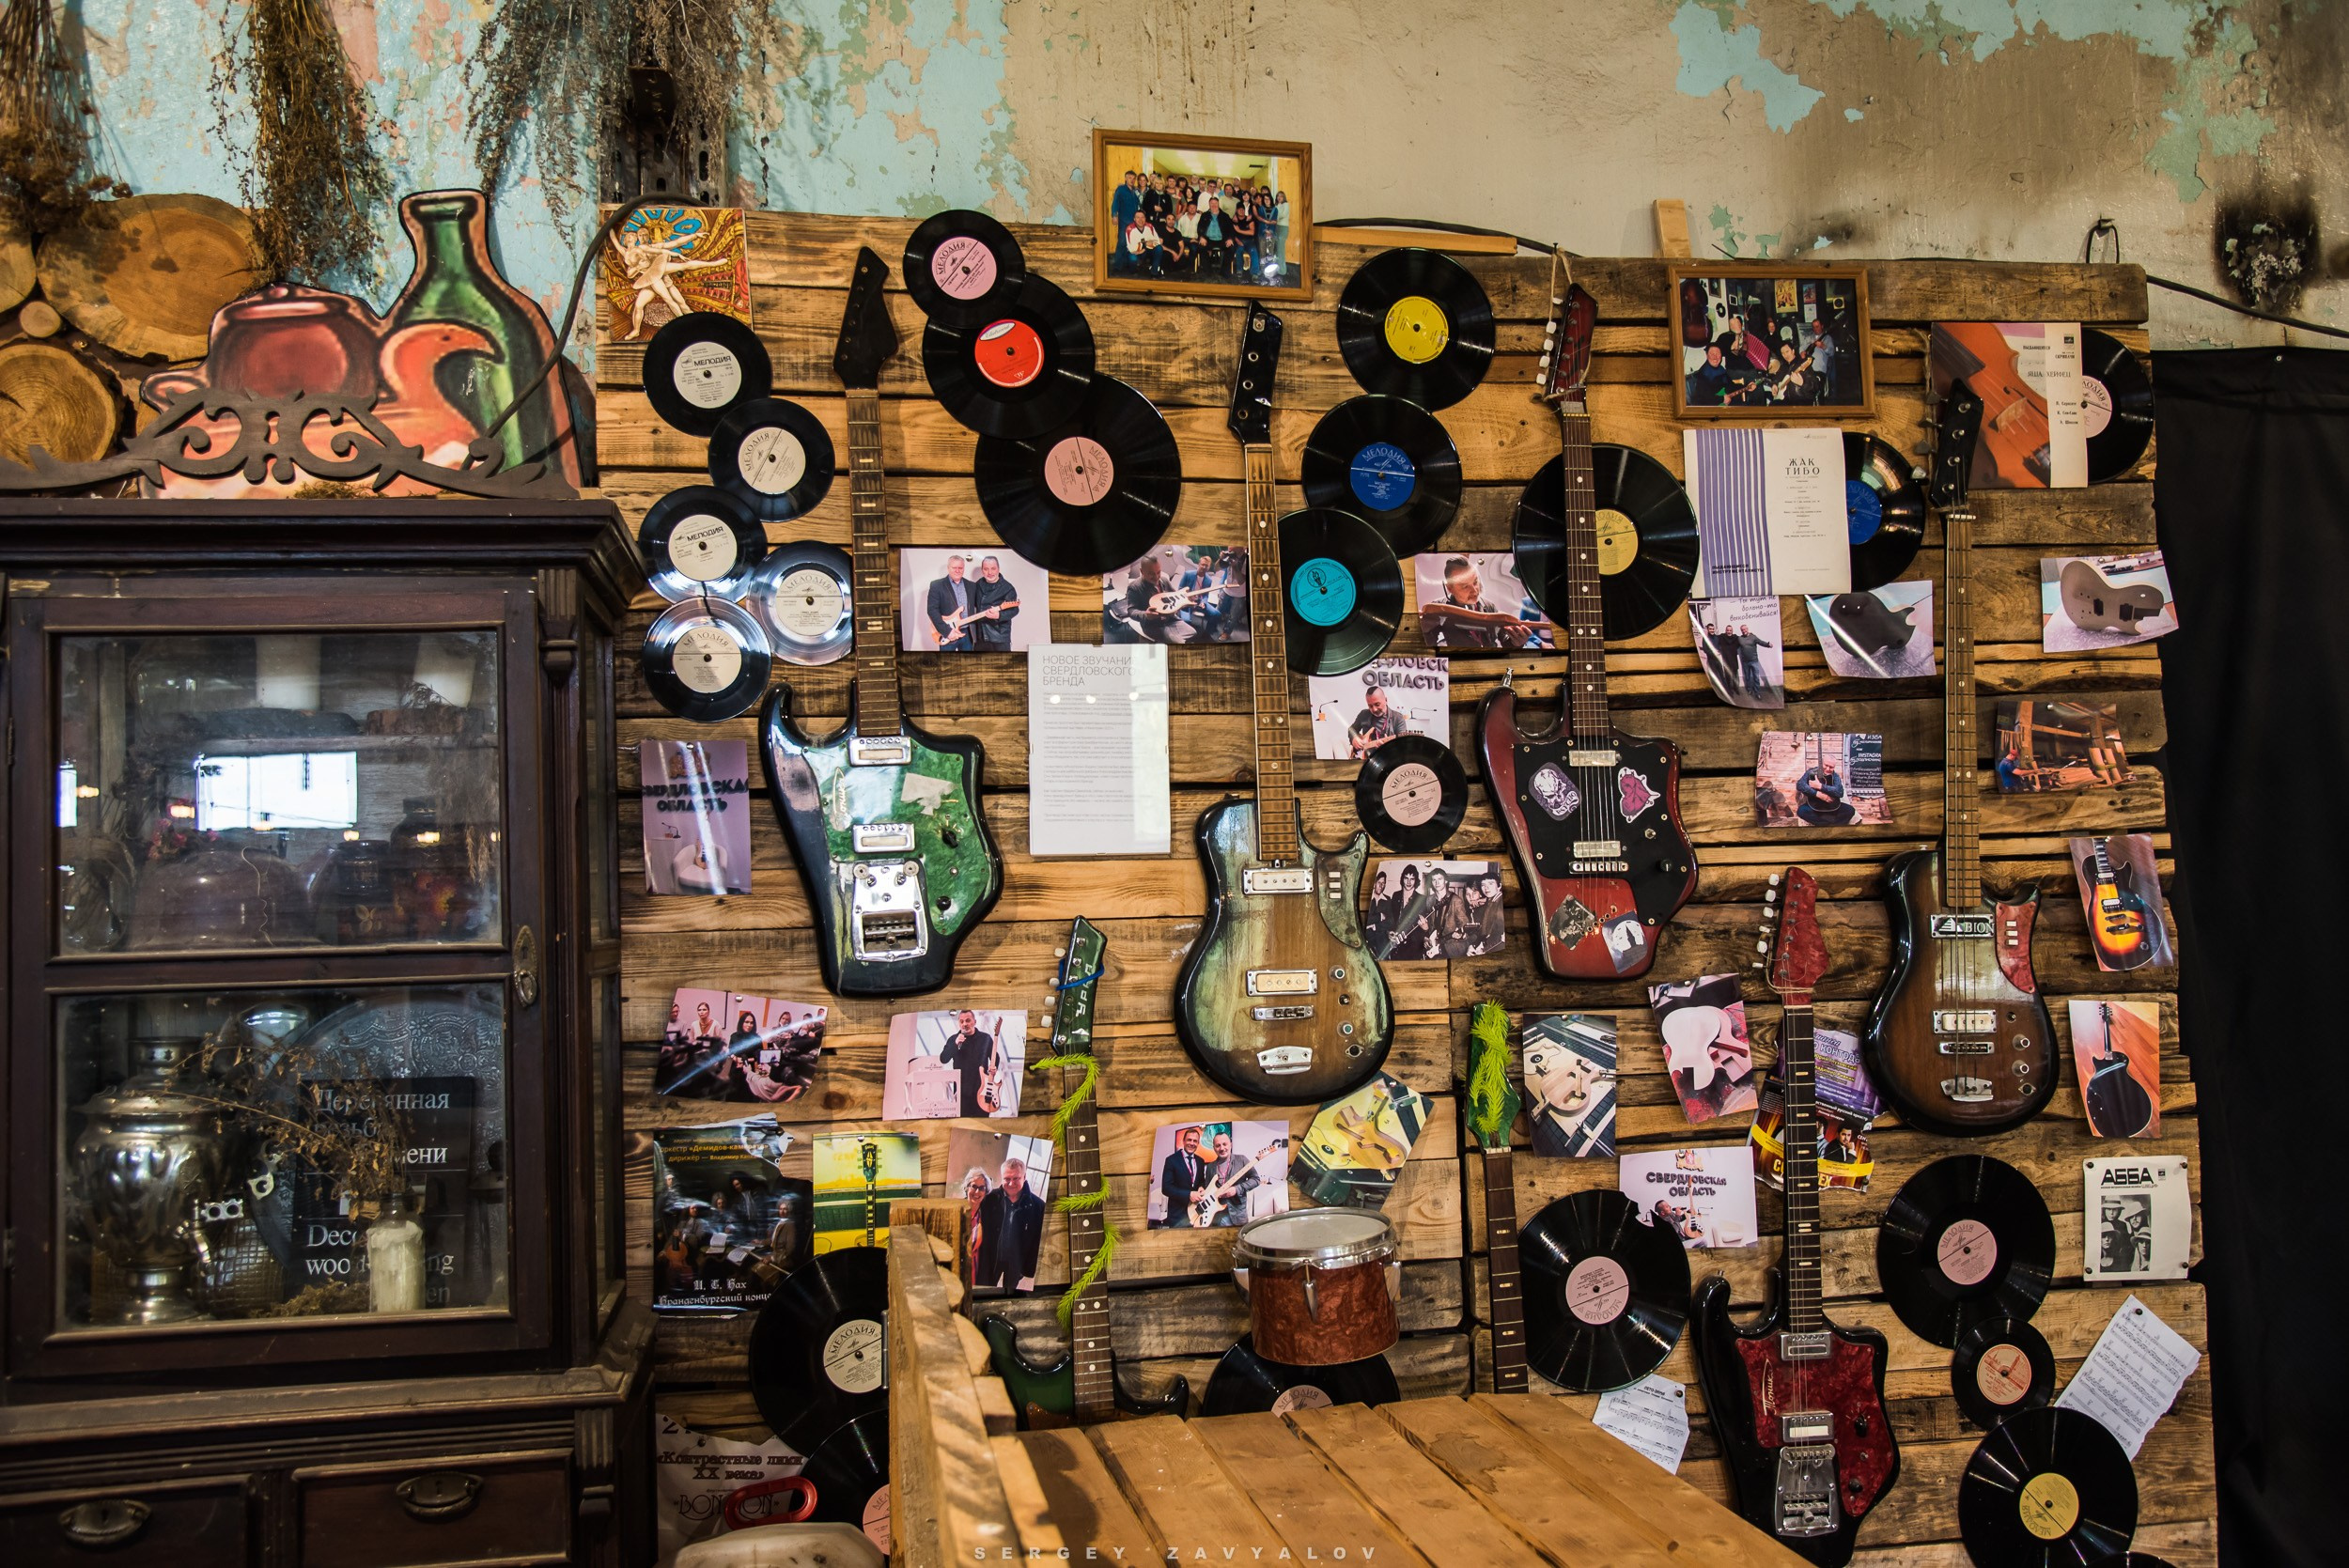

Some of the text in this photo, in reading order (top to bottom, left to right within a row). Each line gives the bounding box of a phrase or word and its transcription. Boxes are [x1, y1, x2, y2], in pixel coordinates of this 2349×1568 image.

[938, 241, 967, 275] МЕЛОДИЯ
[693, 354, 732, 367] МЕЛОДИЯ
[742, 431, 771, 473] МЕЛОДИЯ
[1361, 446, 1408, 467] МЕЛОДИЯ
[1788, 458, 1815, 466] ЖАК
[1088, 445, 1110, 489] МЕЛОДИЯ
[1784, 466, 1821, 475] ТИБО
[686, 525, 724, 542] МЕЛОДИЯ
[786, 573, 832, 591] МЕЛОДИЯ
[683, 631, 730, 647] МЕЛОДИЯ
[1042, 655, 1132, 665] НОВОЕ ЗВУЧАНИ
[1042, 665, 1136, 676] СВЕРДЛОВСКОГО
[1042, 675, 1085, 687] БРЕНДА
[1361, 670, 1445, 691] ОБЛАСТЬ
[1390, 768, 1428, 789] МЕЛОДИЯ
[1940, 1223, 1975, 1249] МЕЛОДИЯ
[1583, 1298, 1623, 1321] МЕЛОДИЯ
[831, 1326, 876, 1354] МЕЛОДИЯ
[1277, 1388, 1319, 1409] МЕЛОДИЯ
[2020, 1505, 2052, 1537] МЕЛОДИЯ
